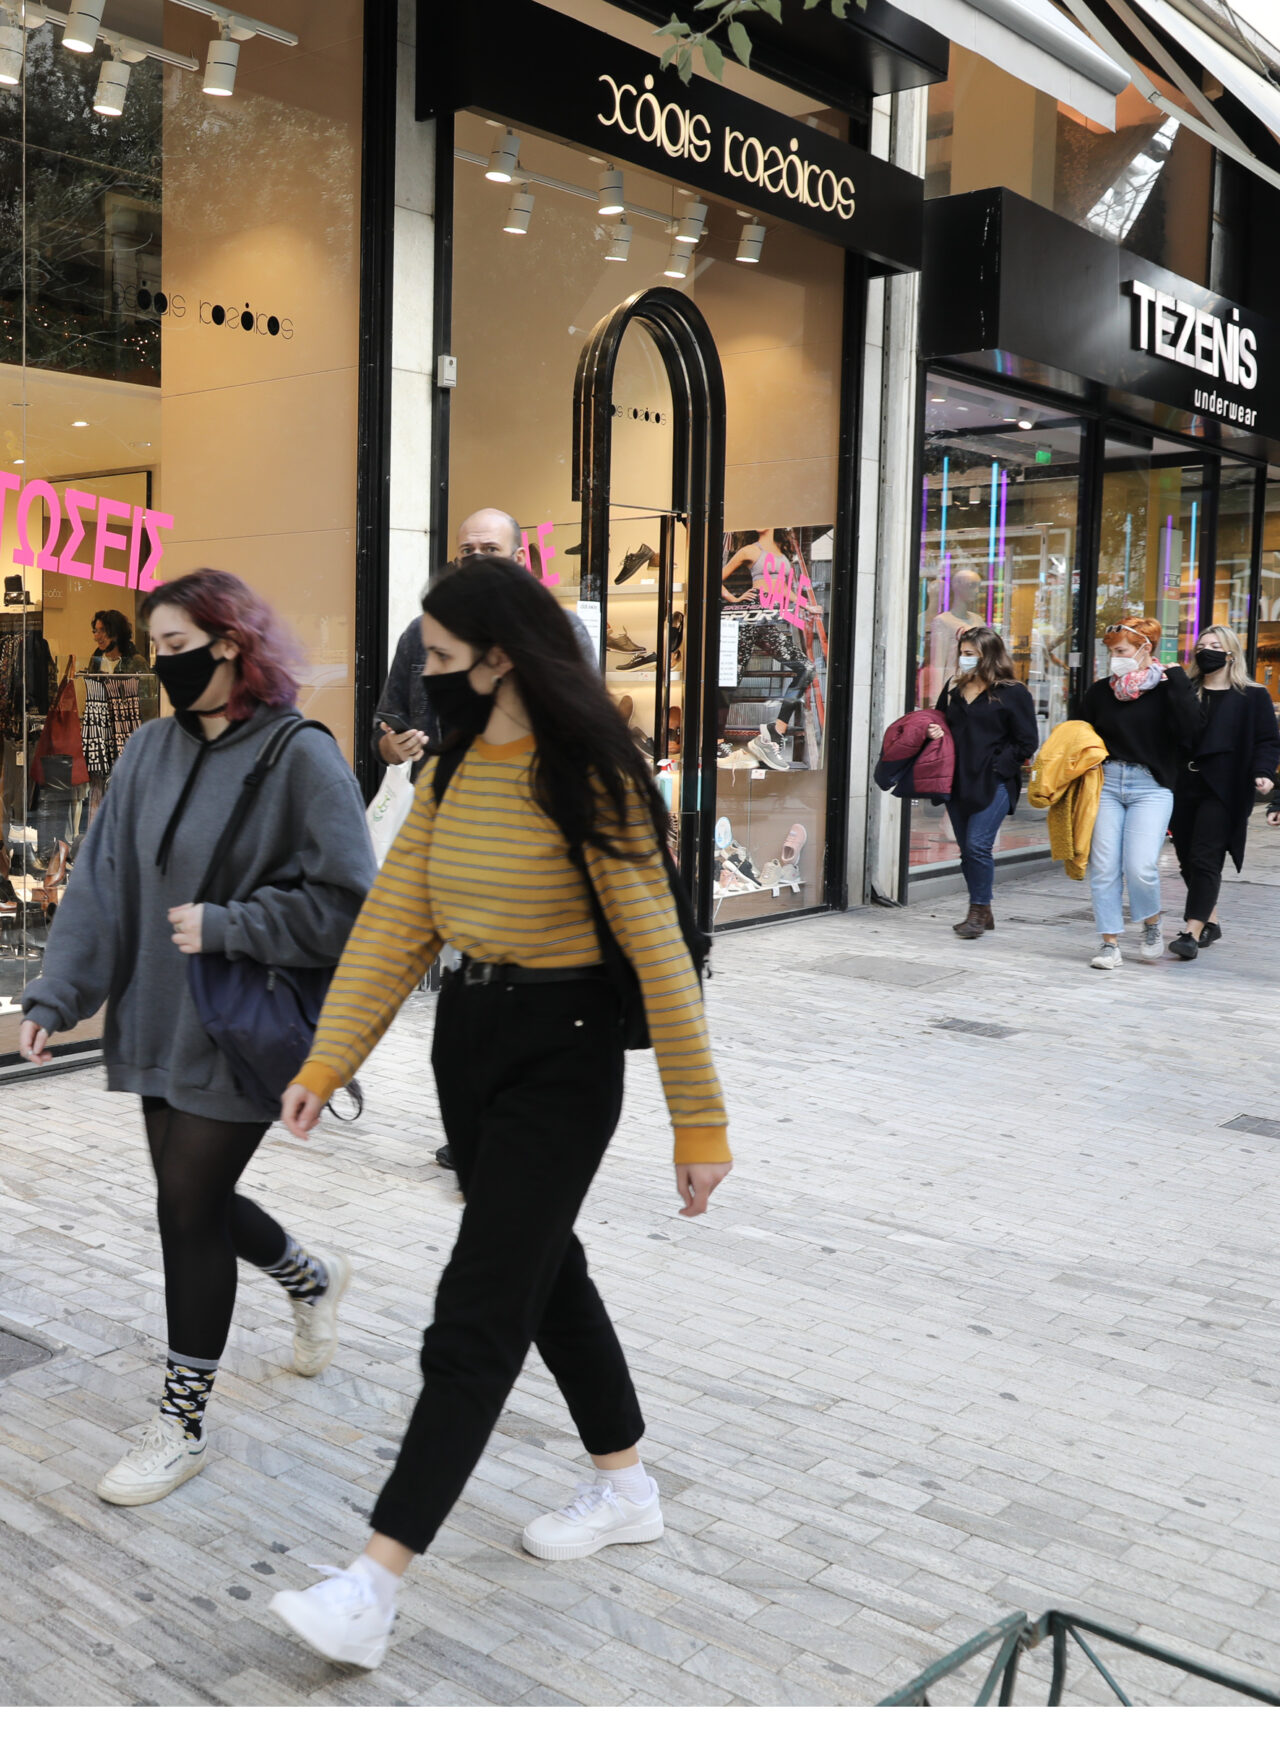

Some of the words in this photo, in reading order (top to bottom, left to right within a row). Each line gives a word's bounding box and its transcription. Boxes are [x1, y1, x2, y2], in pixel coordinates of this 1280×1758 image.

[1132, 279, 1258, 390] TEZENIS
[1194, 388, 1258, 427] underwear
[759, 552, 812, 631] SALE
